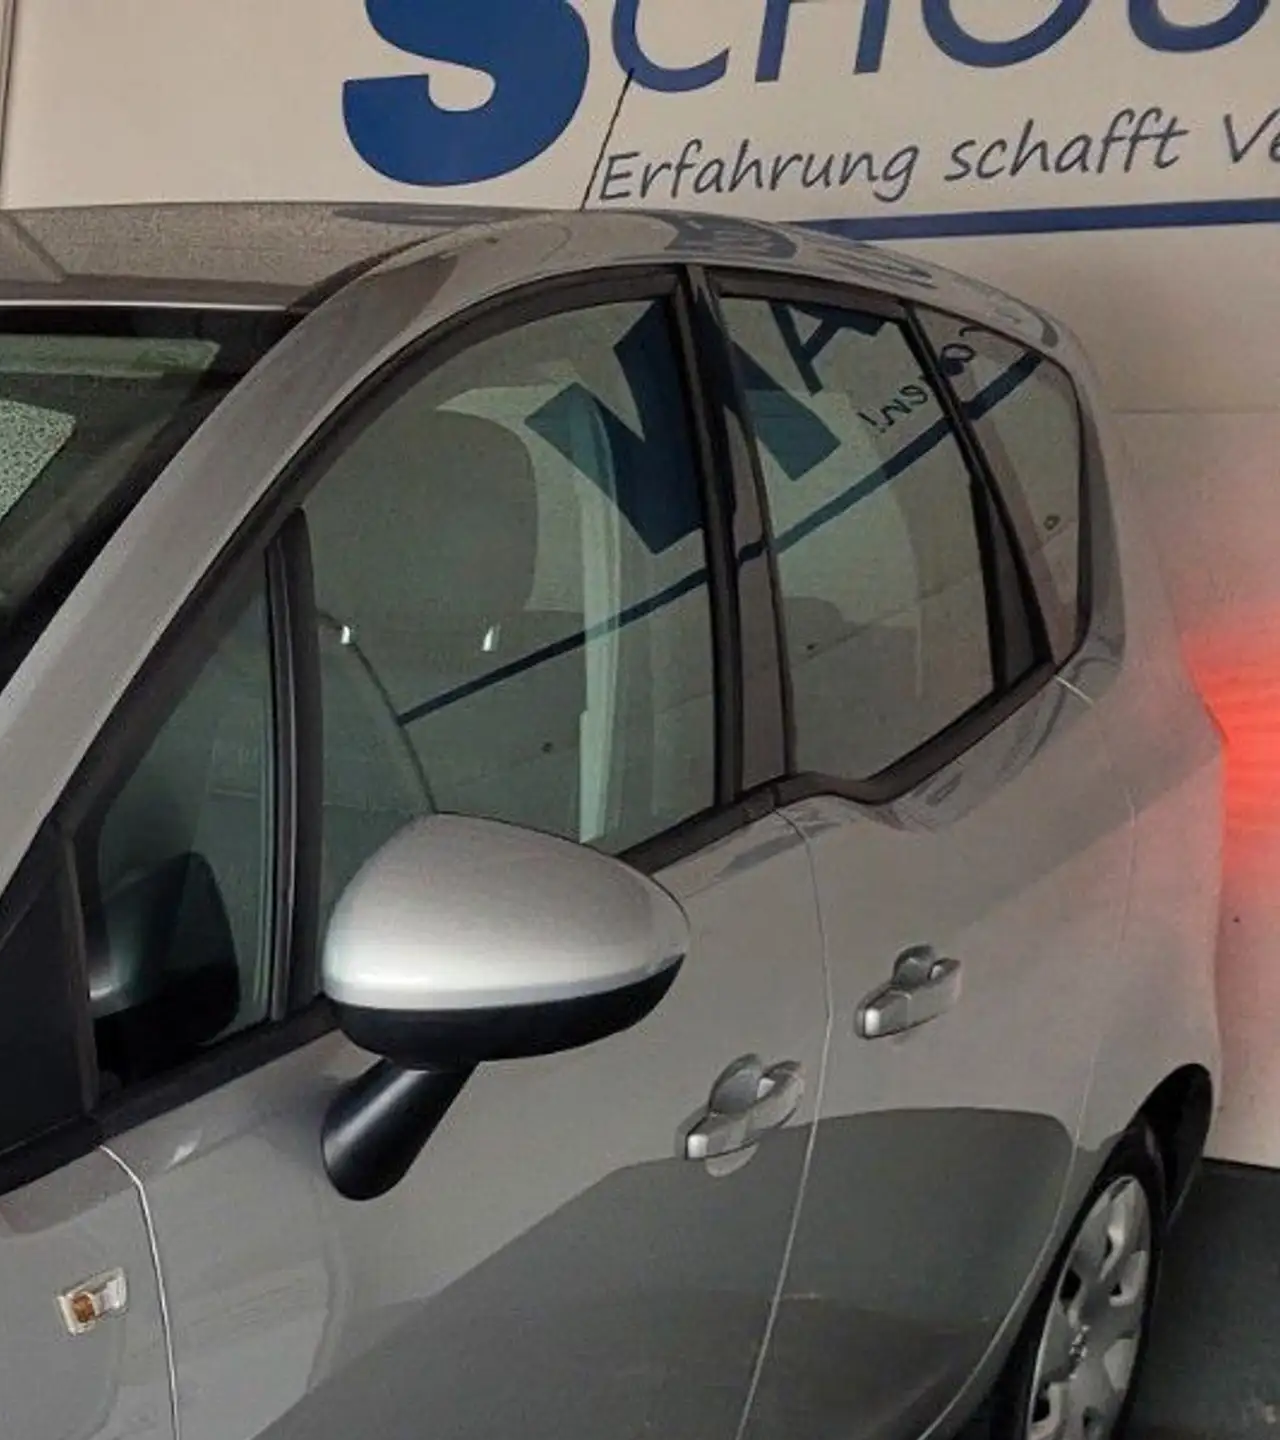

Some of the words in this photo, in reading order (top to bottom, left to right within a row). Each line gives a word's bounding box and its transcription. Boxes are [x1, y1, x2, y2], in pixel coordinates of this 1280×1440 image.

[342, 0, 1272, 187] SCH
[599, 137, 920, 203] Erfahrung
[944, 106, 1189, 182] schafft
